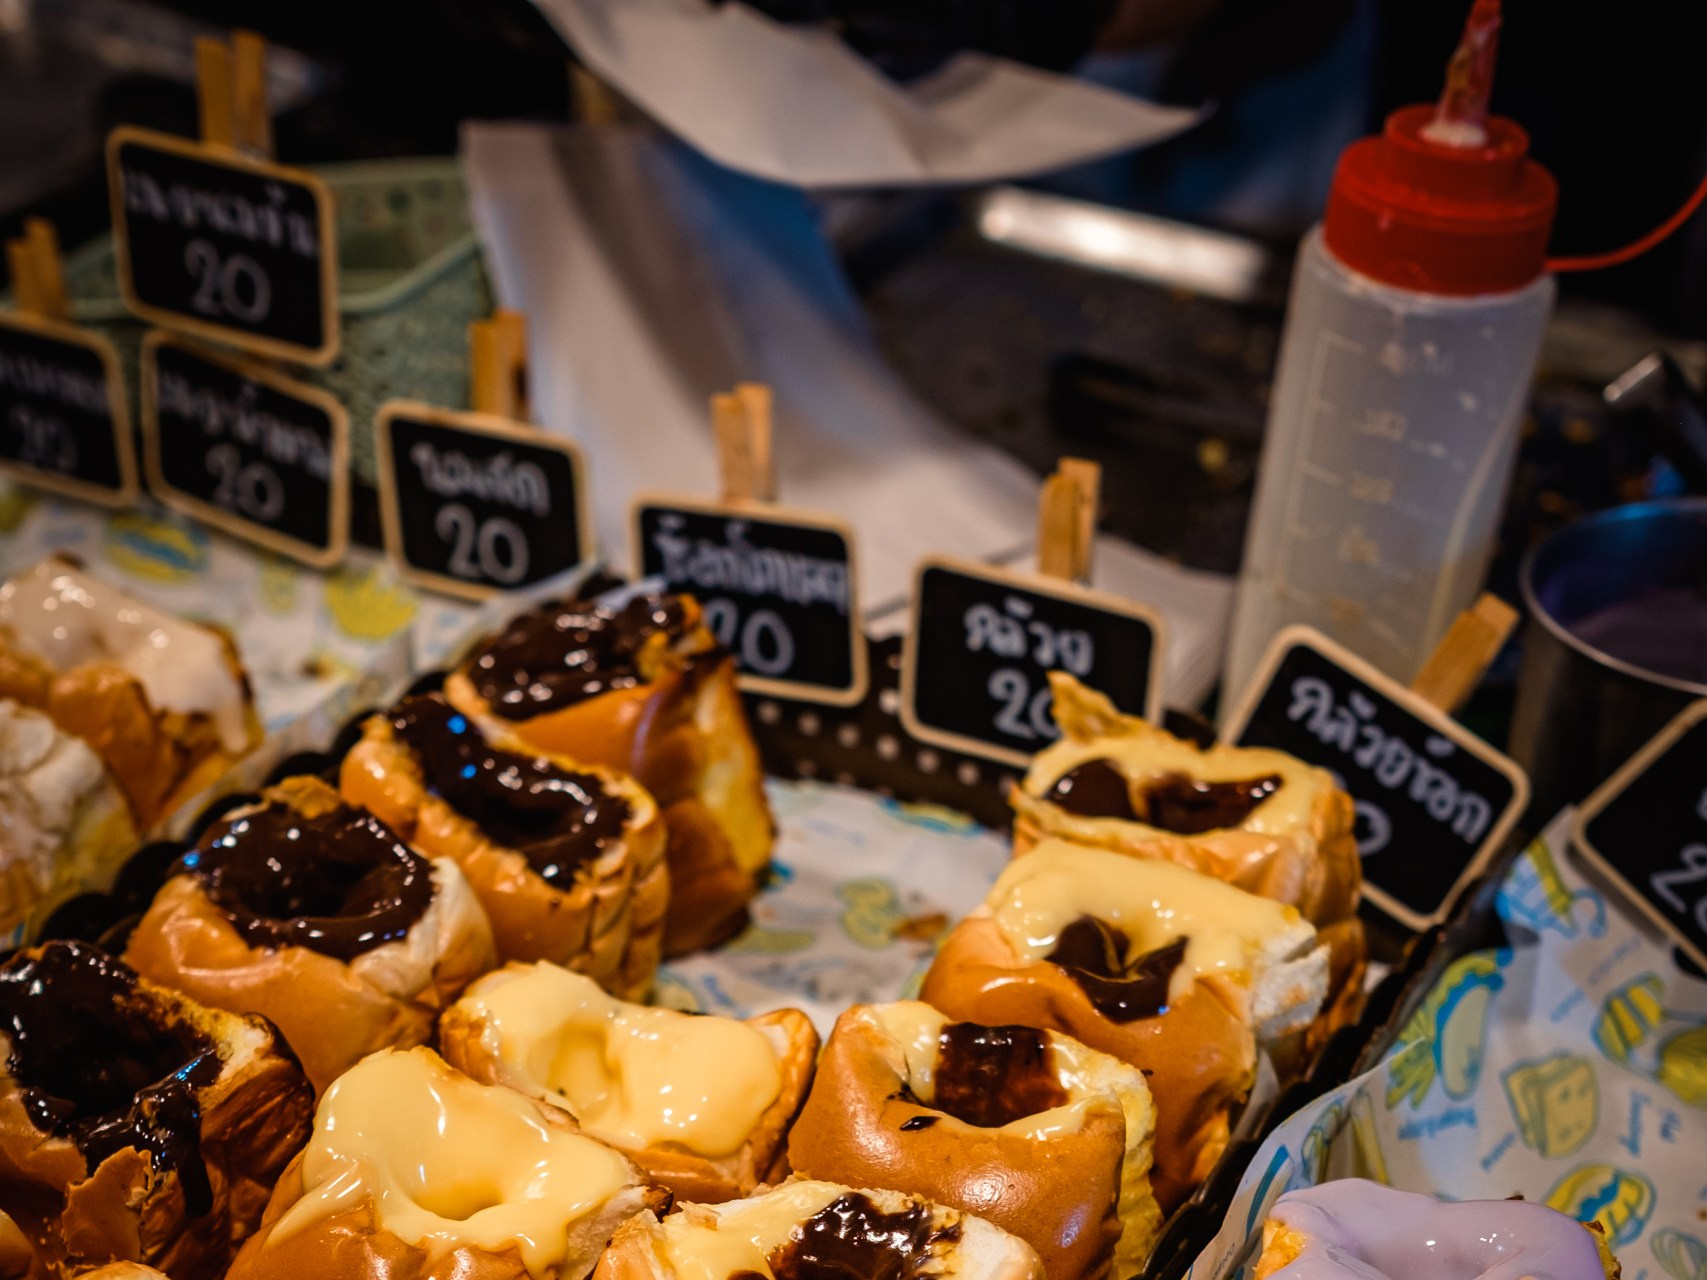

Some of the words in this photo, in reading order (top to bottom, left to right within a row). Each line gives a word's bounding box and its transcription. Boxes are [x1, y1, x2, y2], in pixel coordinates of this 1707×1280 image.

[183, 236, 272, 323] 20
[205, 442, 286, 521] 20
[434, 501, 530, 585] 20
[963, 594, 1096, 677] กล้วย
